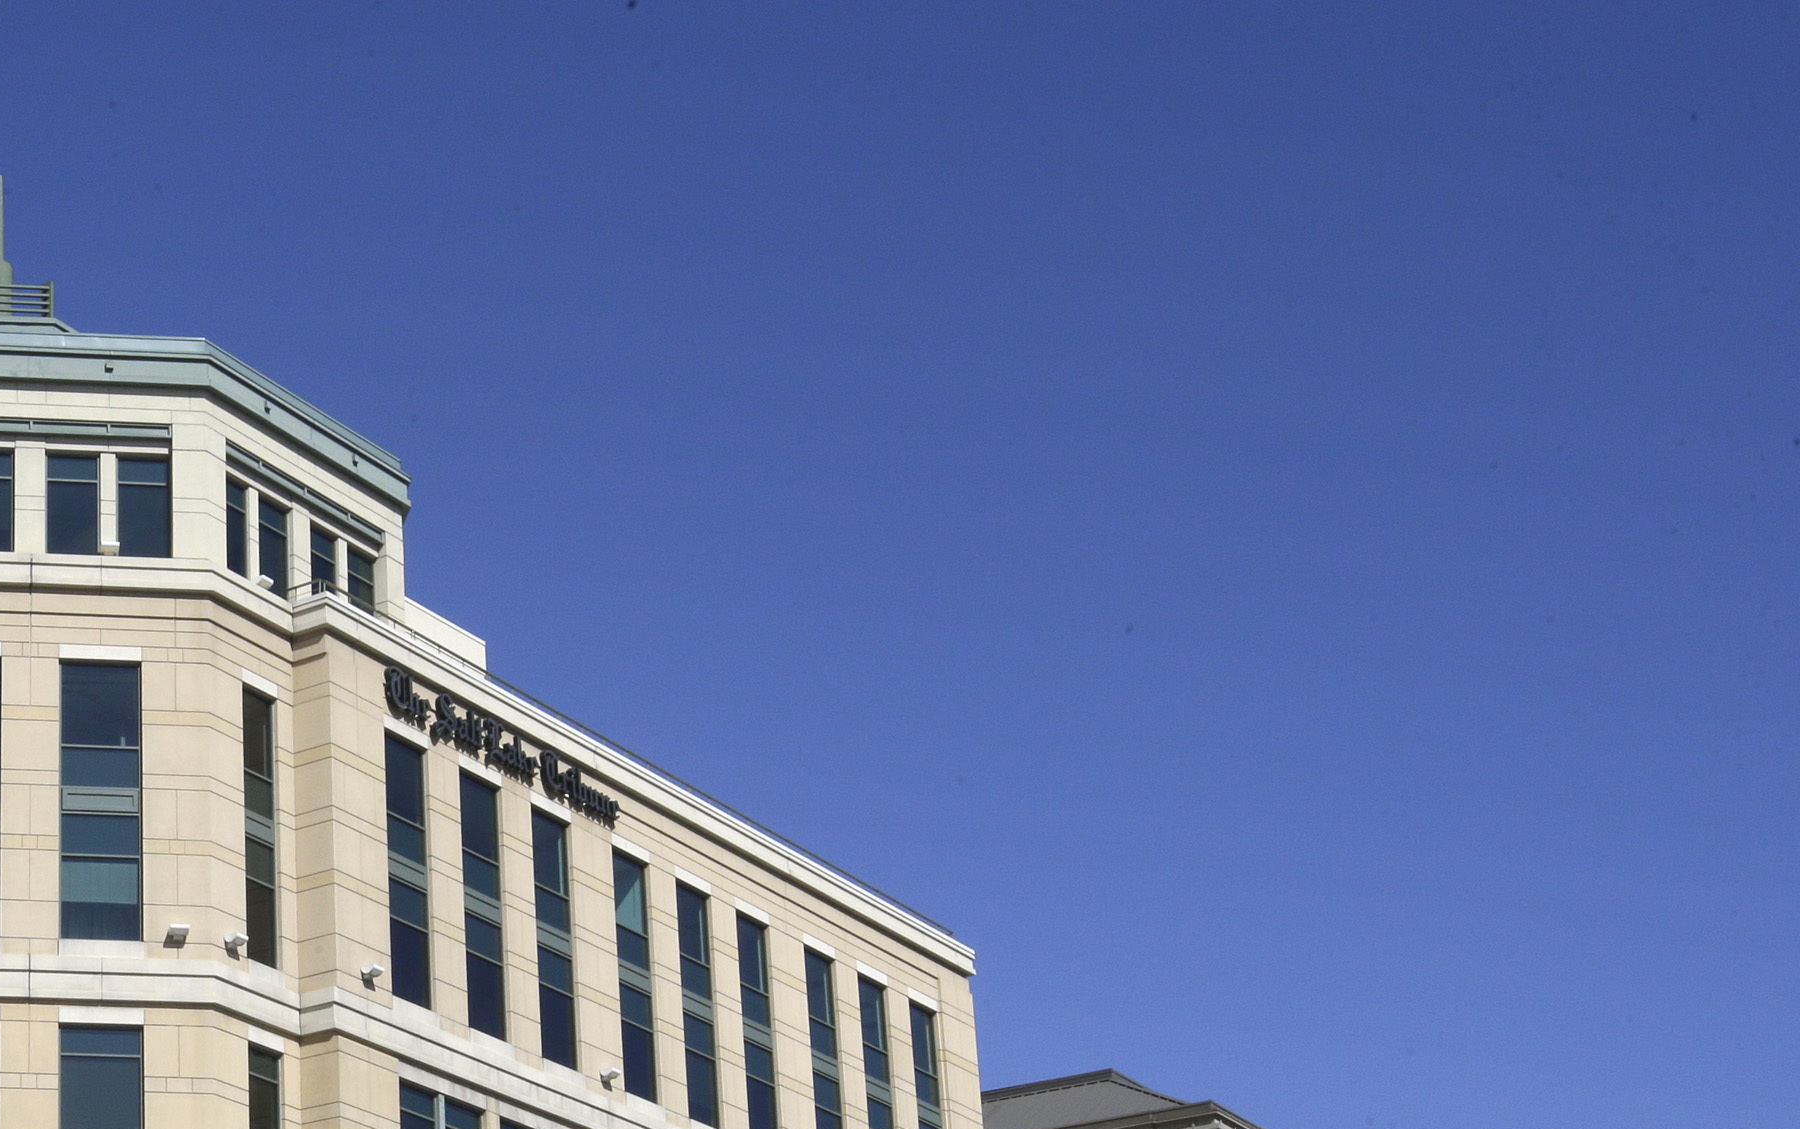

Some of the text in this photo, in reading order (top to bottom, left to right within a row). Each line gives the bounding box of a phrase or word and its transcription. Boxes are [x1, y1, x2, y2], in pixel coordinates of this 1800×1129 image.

[384, 665, 620, 820] The Salt Lake Tribune
